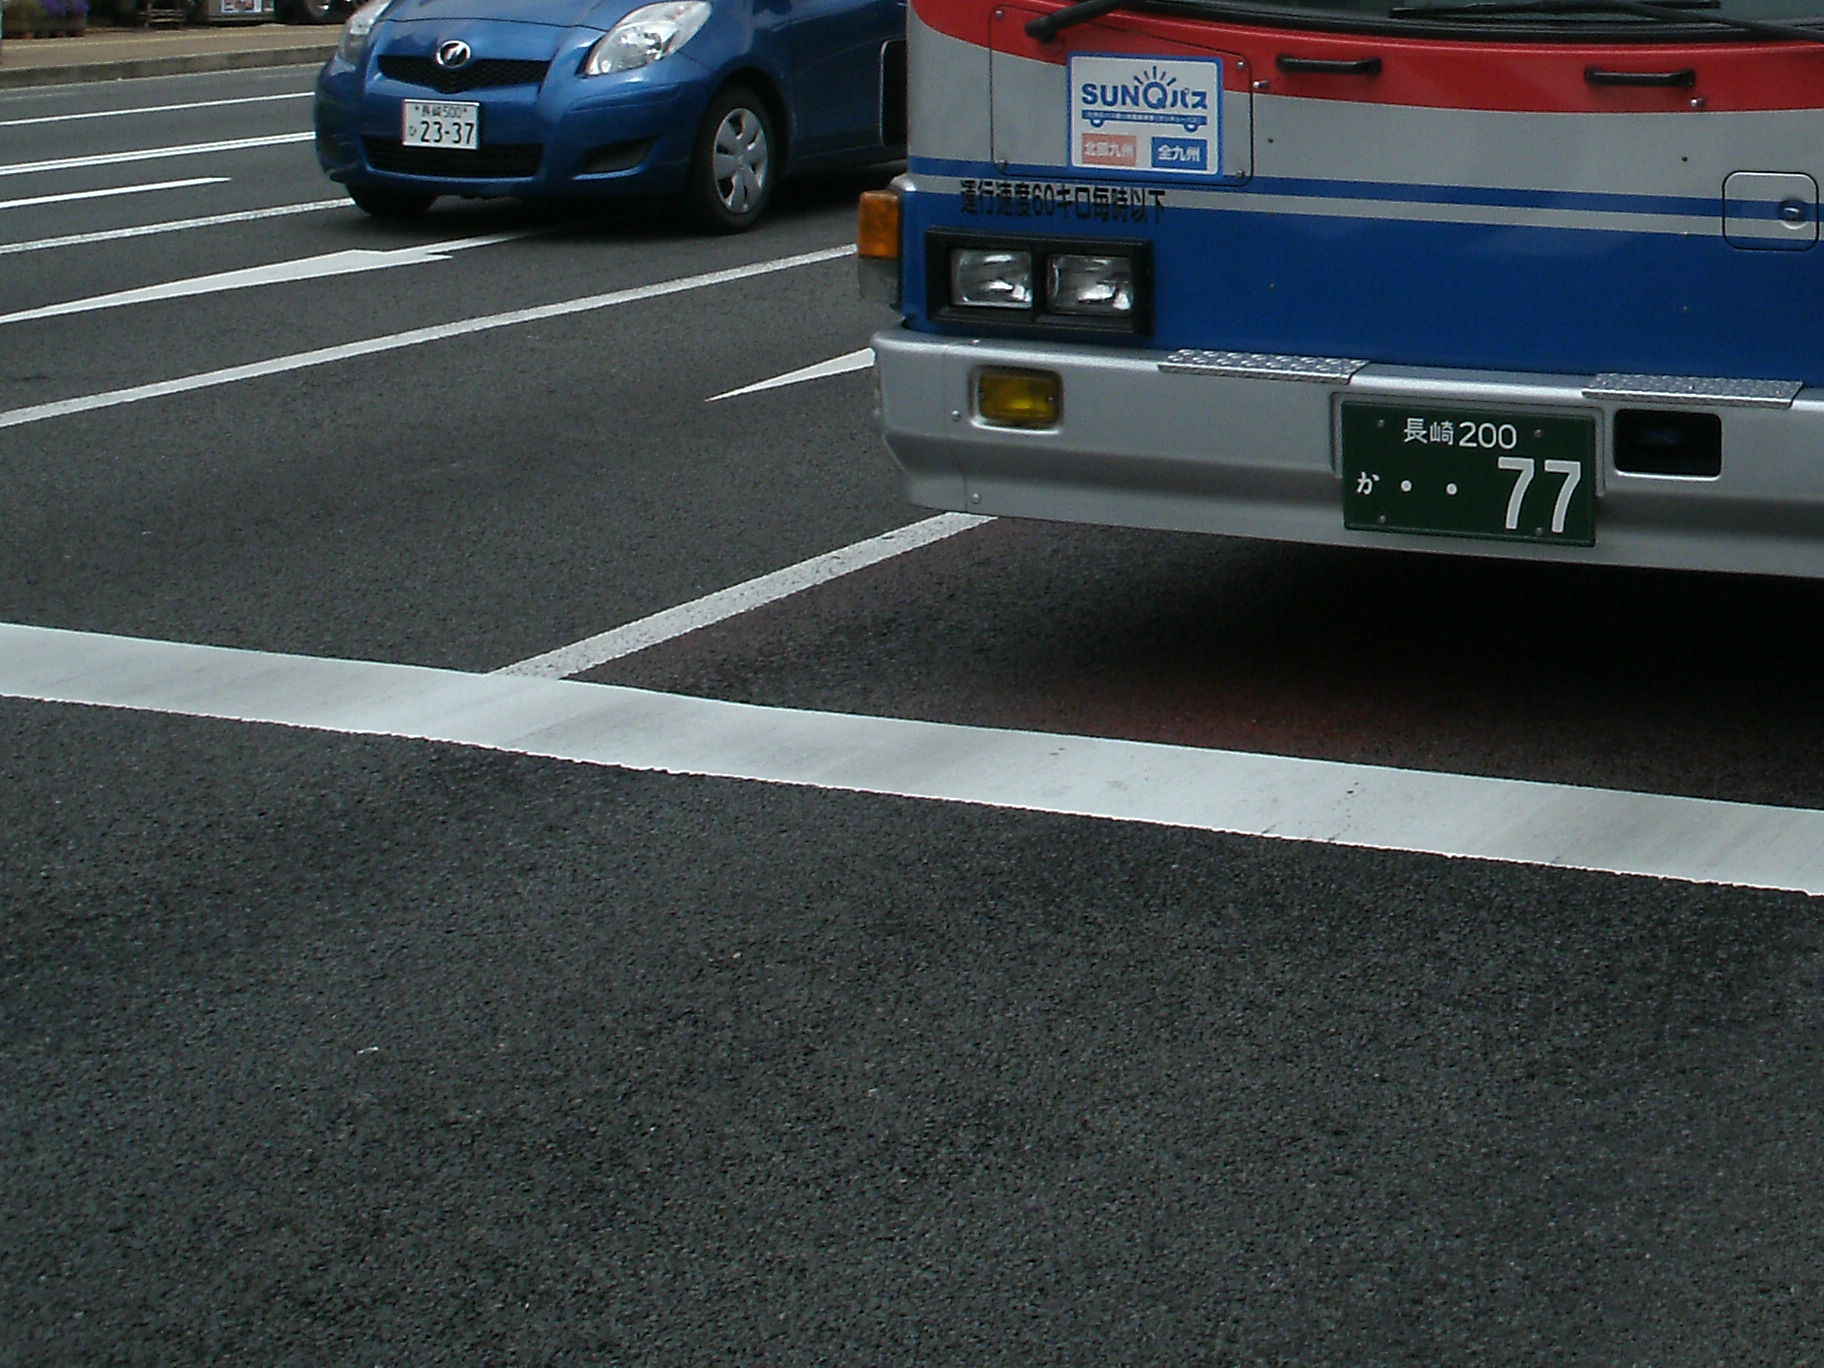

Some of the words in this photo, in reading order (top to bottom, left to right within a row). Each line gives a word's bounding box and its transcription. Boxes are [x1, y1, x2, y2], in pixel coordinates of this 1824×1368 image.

[420, 121, 475, 145] 23-37
[1157, 143, 1201, 163] 全九州
[1356, 470, 1380, 496] か
